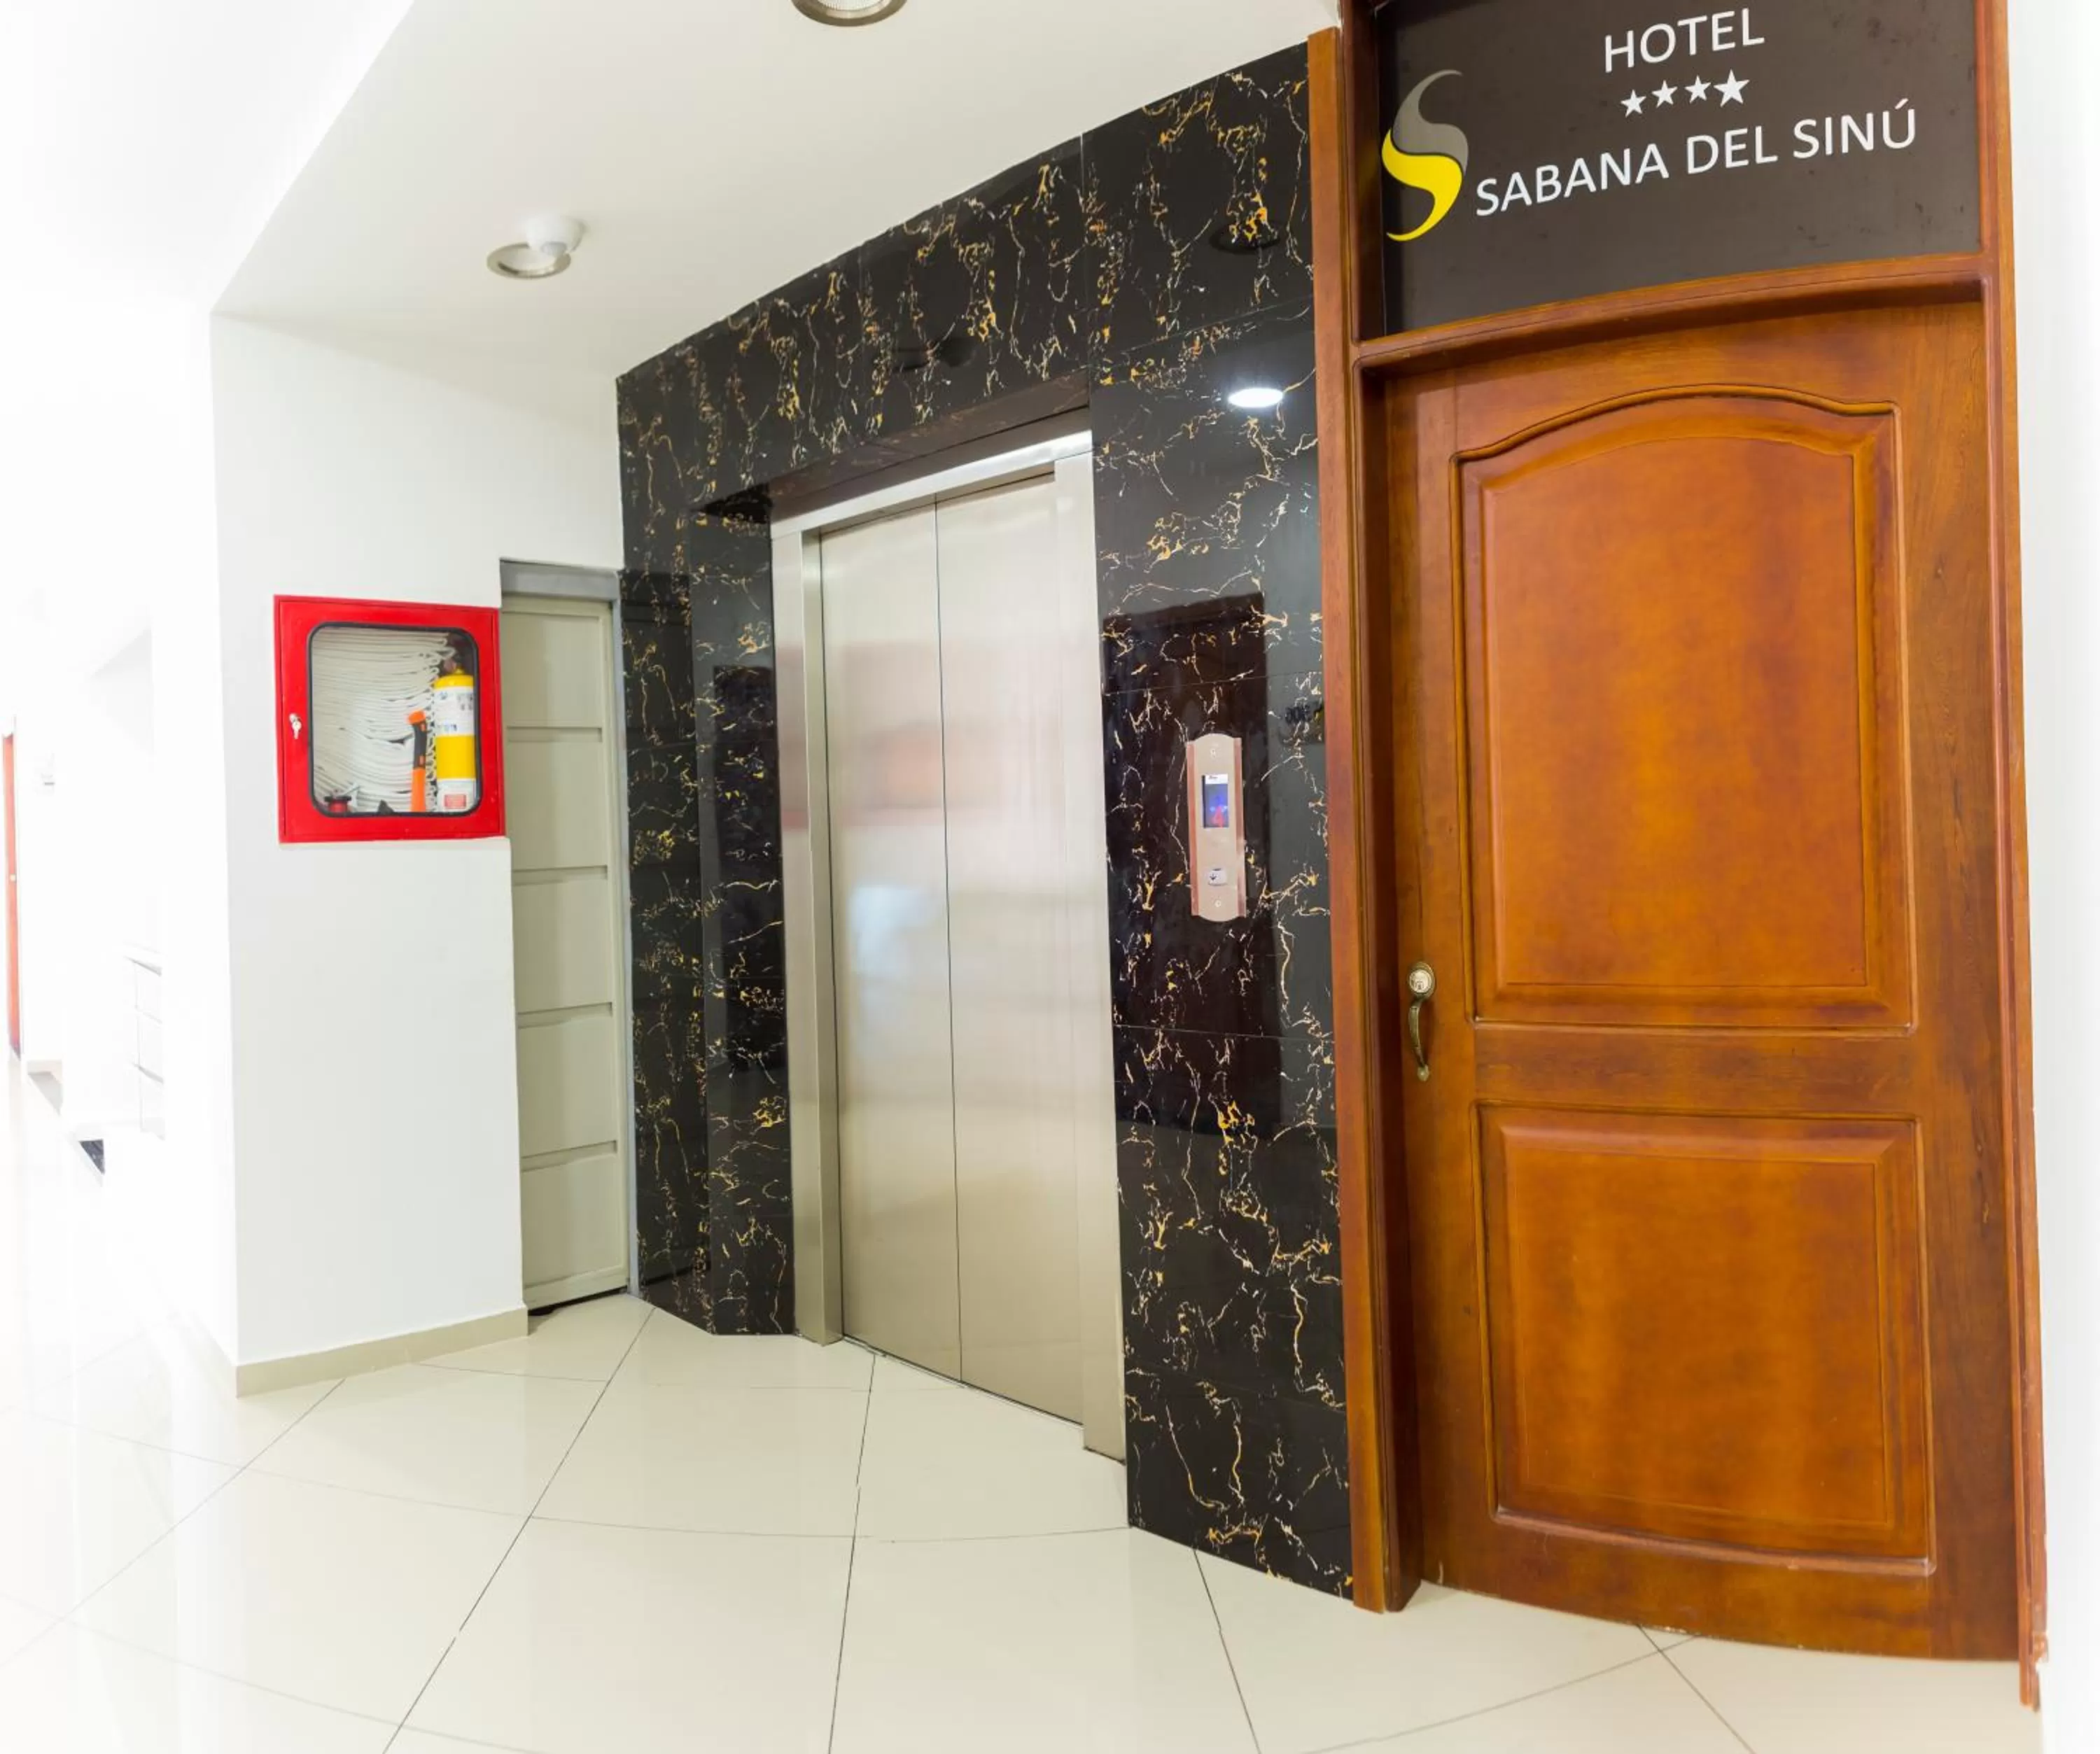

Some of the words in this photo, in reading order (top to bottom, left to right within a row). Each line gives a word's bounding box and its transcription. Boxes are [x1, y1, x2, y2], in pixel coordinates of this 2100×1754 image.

[1604, 8, 1765, 73] HOTEL
[1476, 143, 1670, 216] SABANA
[1687, 125, 1778, 174] DEL
[1793, 98, 1916, 159] SINÚ
